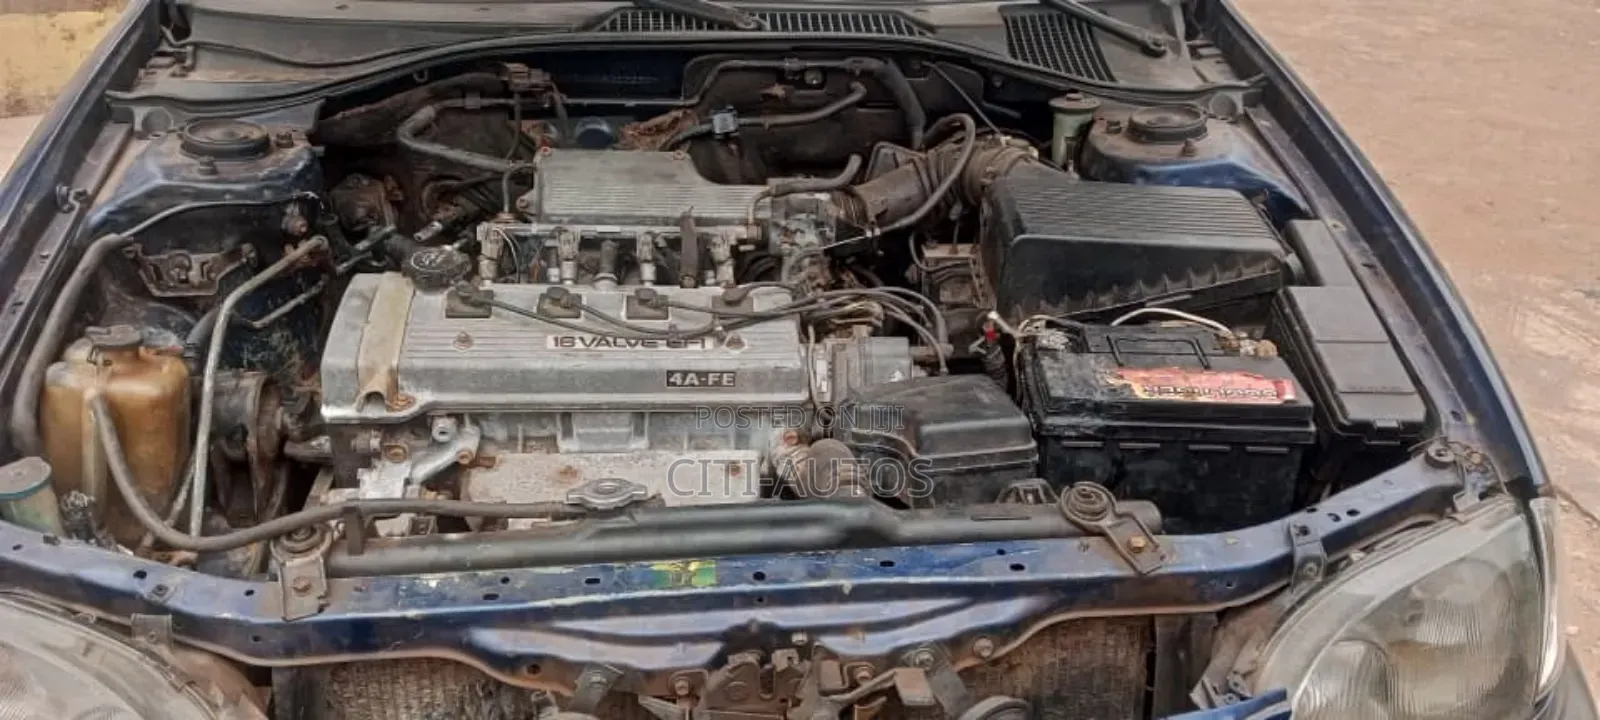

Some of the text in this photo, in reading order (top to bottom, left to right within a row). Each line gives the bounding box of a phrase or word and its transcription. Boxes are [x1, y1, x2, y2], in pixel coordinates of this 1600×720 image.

[553, 336, 575, 348] 16
[578, 336, 659, 349] VALVE
[668, 371, 735, 386] 4A-FE
